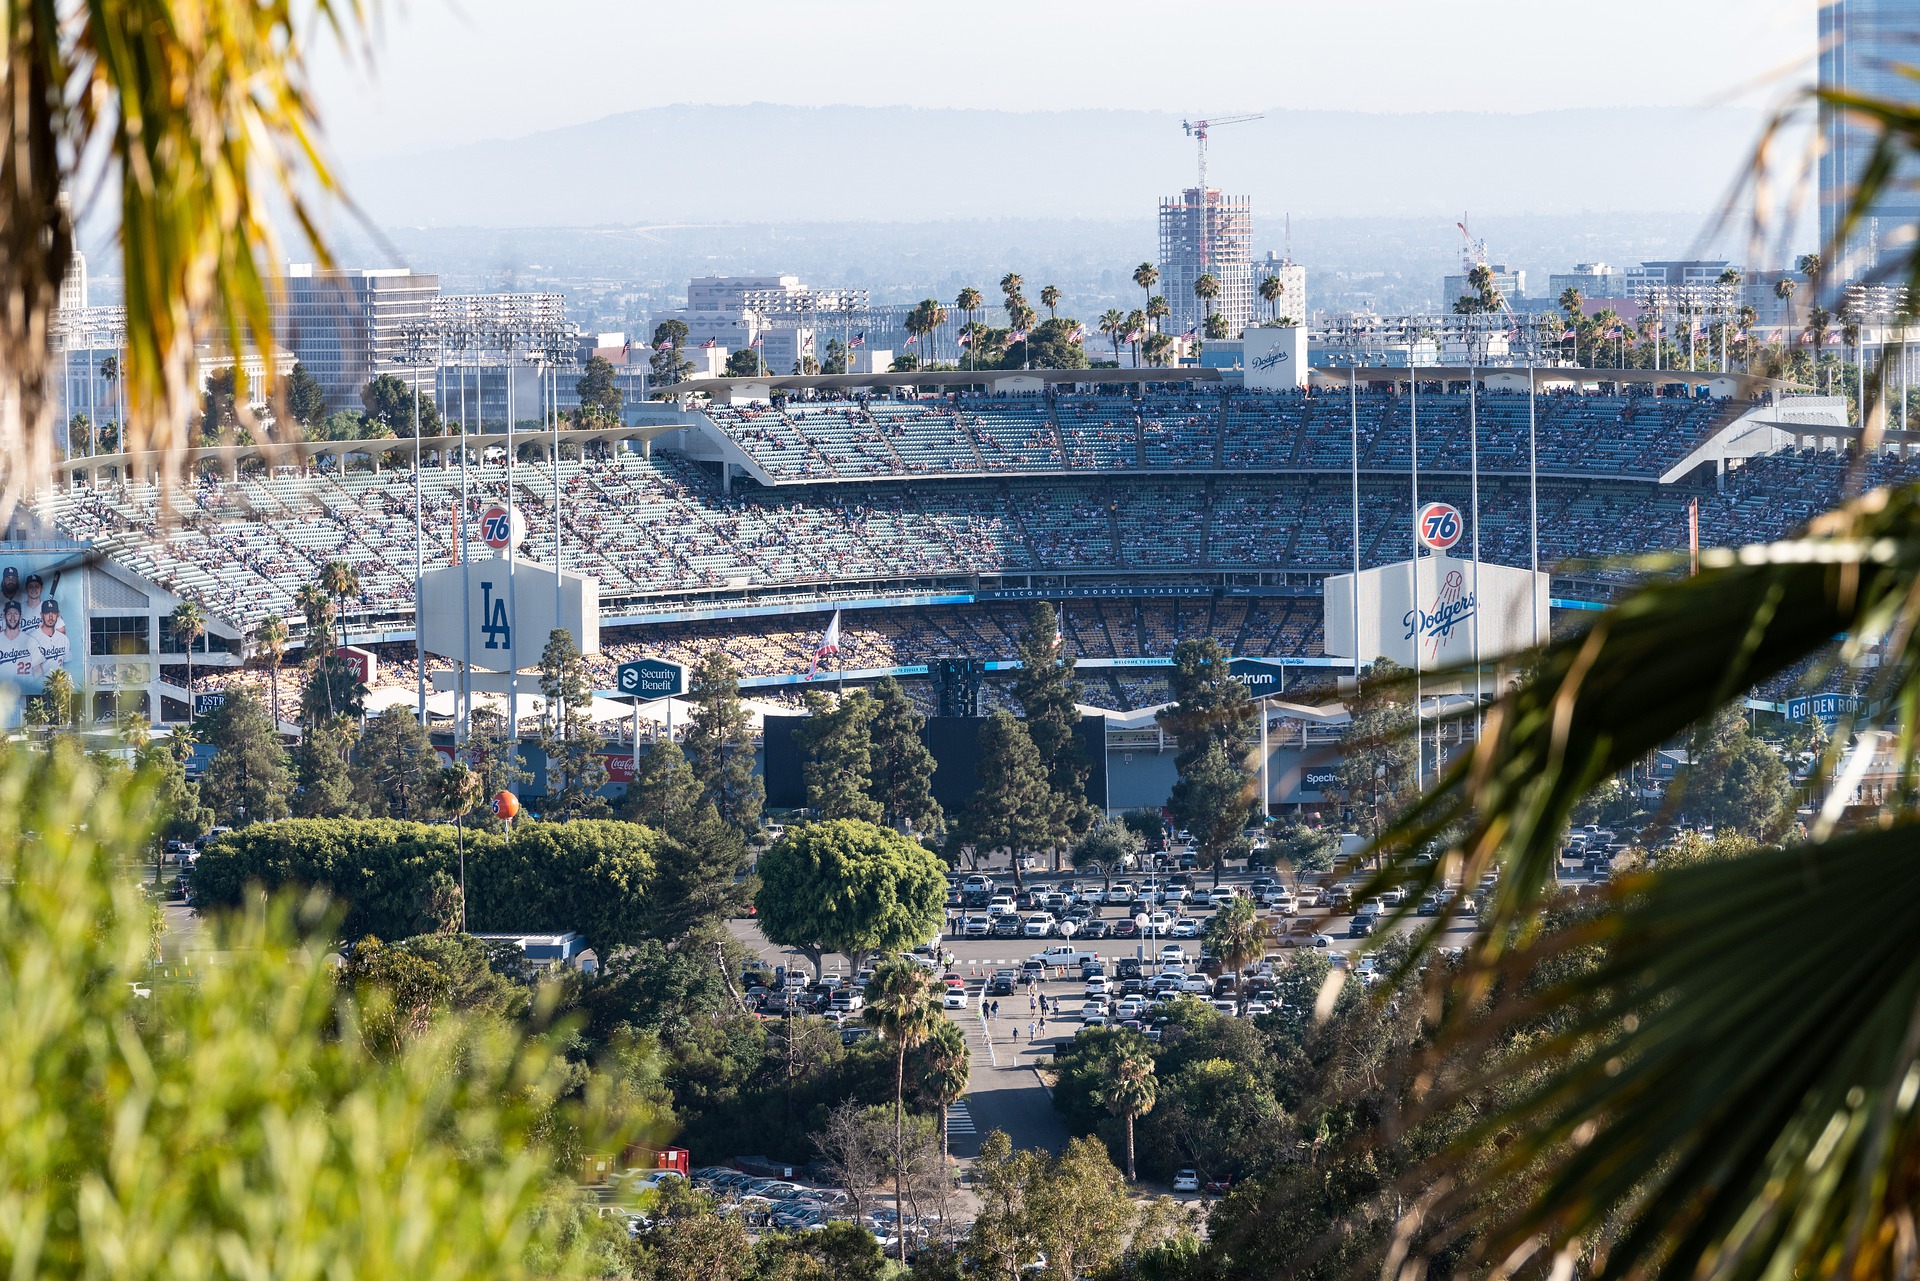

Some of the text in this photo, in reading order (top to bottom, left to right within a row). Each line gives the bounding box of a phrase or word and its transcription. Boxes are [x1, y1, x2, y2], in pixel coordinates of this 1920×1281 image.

[1252, 351, 1288, 370] Dodgers
[484, 515, 509, 541] 76
[1424, 512, 1458, 540] 76
[20, 616, 43, 632] Dodg
[481, 582, 510, 649] LA
[1403, 592, 1480, 640] Dodgers
[17, 661, 31, 675] 22
[641, 668, 676, 681] Security
[642, 680, 671, 690] Benefit
